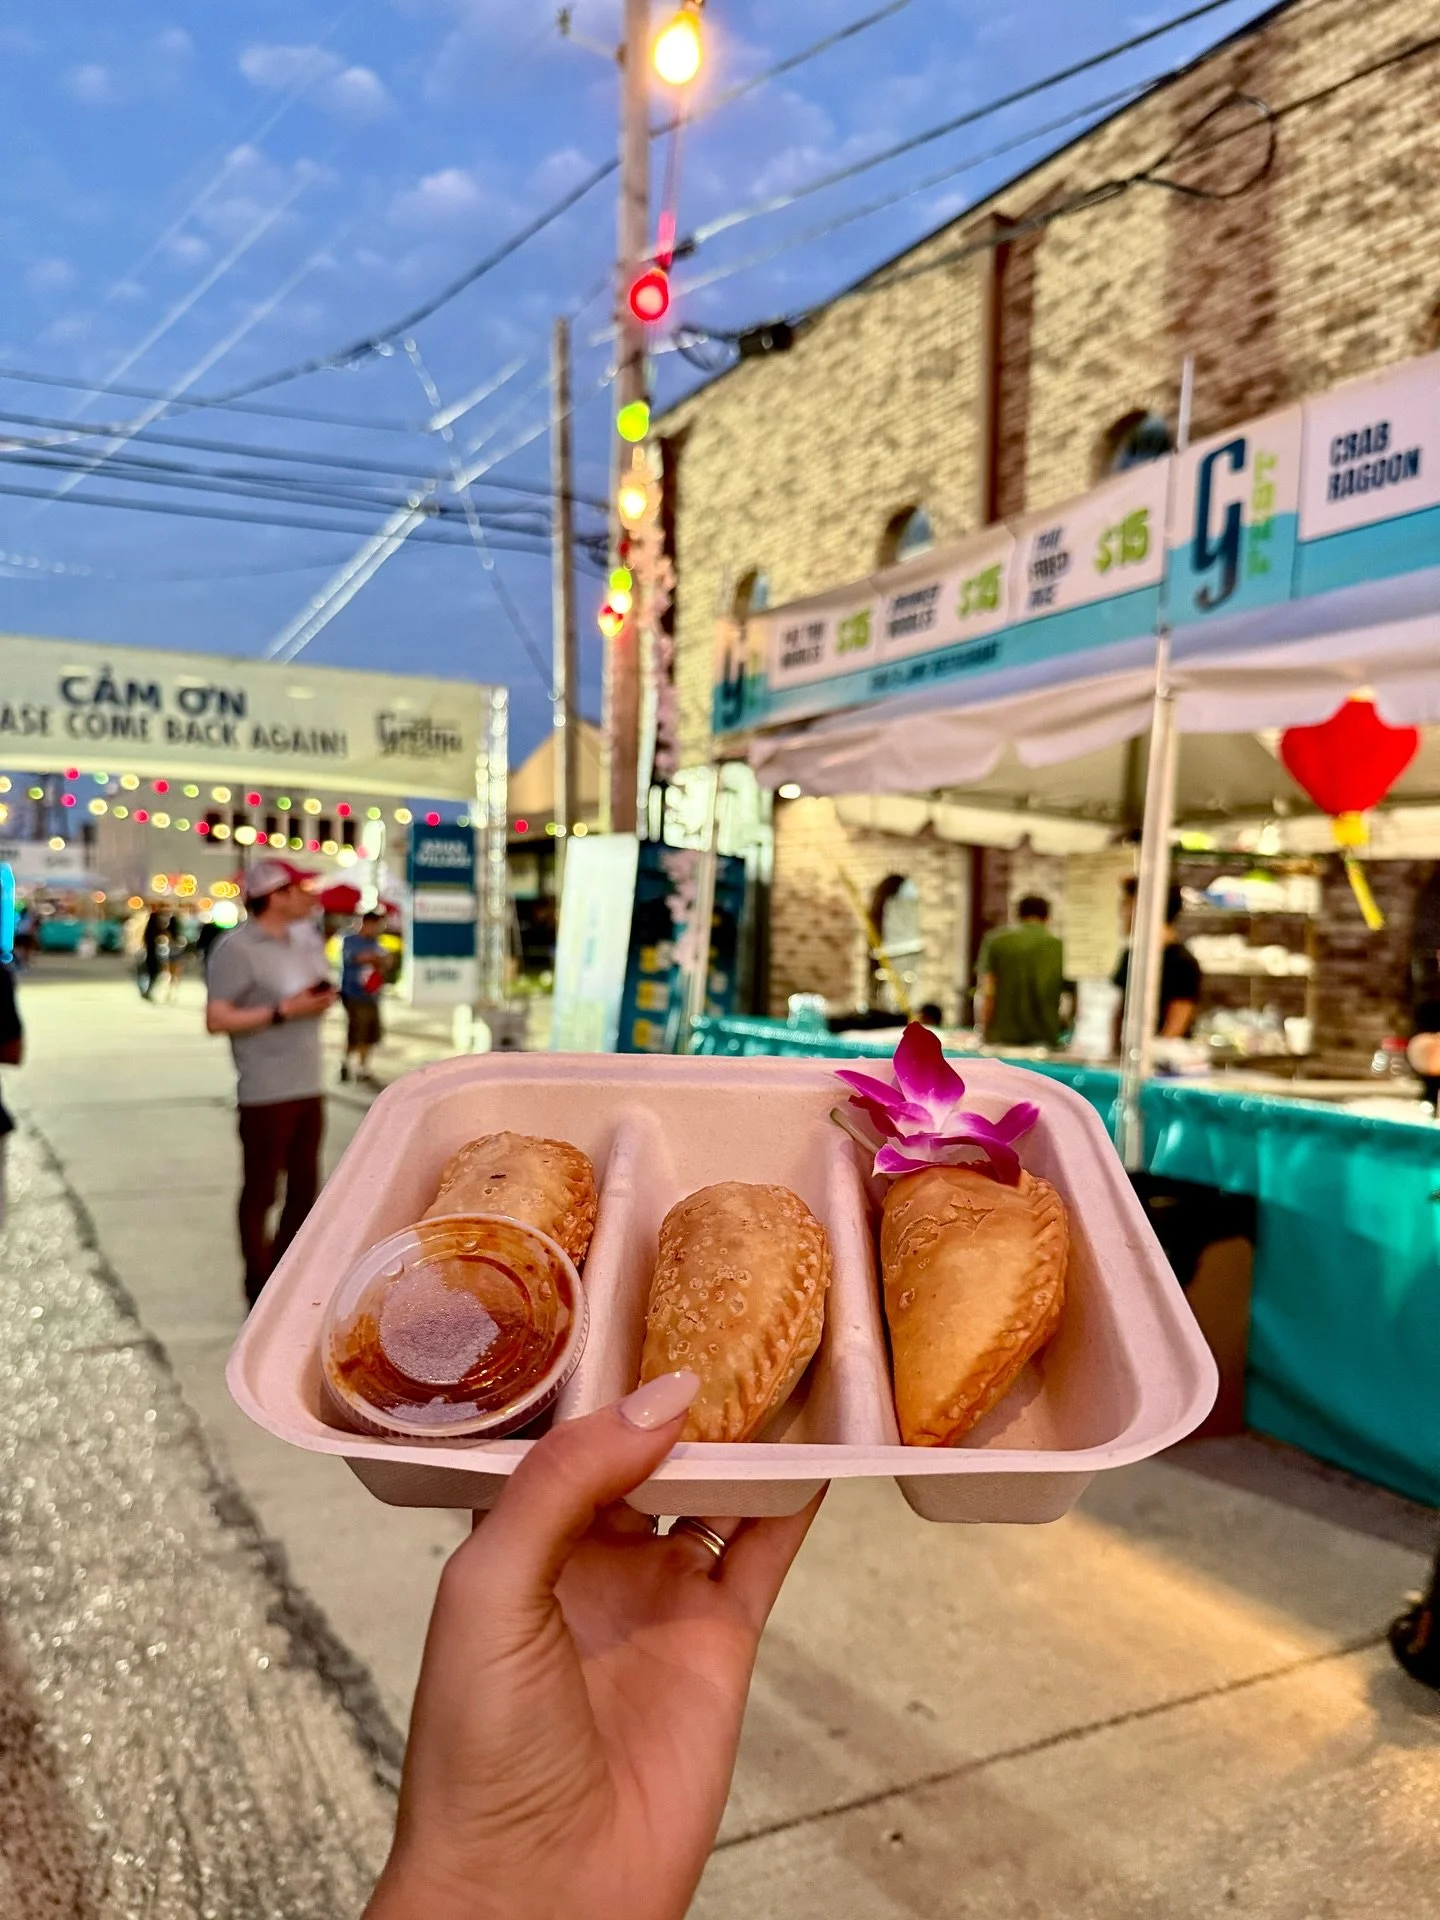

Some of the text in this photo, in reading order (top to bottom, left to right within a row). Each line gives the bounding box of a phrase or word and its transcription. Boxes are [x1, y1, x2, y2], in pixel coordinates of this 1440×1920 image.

[1330, 422, 1390, 467] CRAB
[1328, 448, 1421, 502] RAGOON
[67, 711, 150, 743] COME
[166, 717, 238, 746] BACK
[251, 720, 348, 757] AGAIN!
